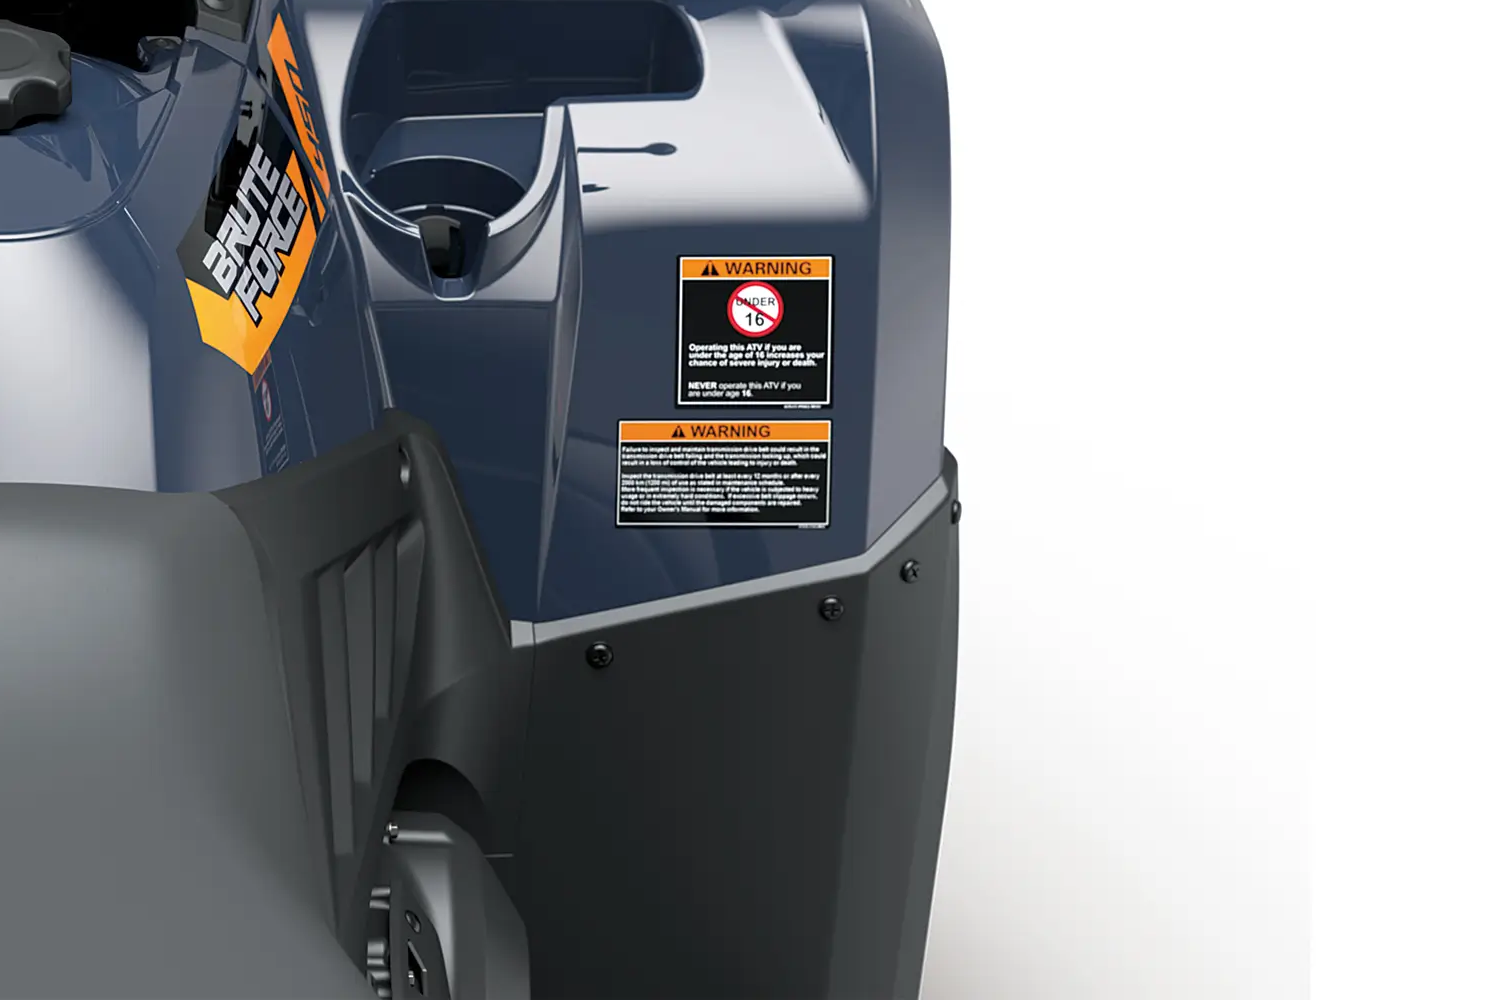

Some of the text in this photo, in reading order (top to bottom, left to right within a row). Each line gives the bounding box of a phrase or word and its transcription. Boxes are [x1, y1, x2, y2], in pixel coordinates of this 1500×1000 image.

[202, 143, 280, 295] BRUTE
[234, 174, 305, 323] FORCE
[725, 262, 812, 275] WARNING
[736, 297, 776, 306] UNDER
[745, 313, 765, 326] 16
[746, 343, 762, 352] ATV
[764, 343, 770, 352] if
[713, 352, 726, 360] the
[755, 351, 764, 360] 16
[756, 359, 780, 368] injury
[718, 383, 747, 391] operate
[748, 382, 762, 391] this
[691, 426, 770, 438] WARNING
